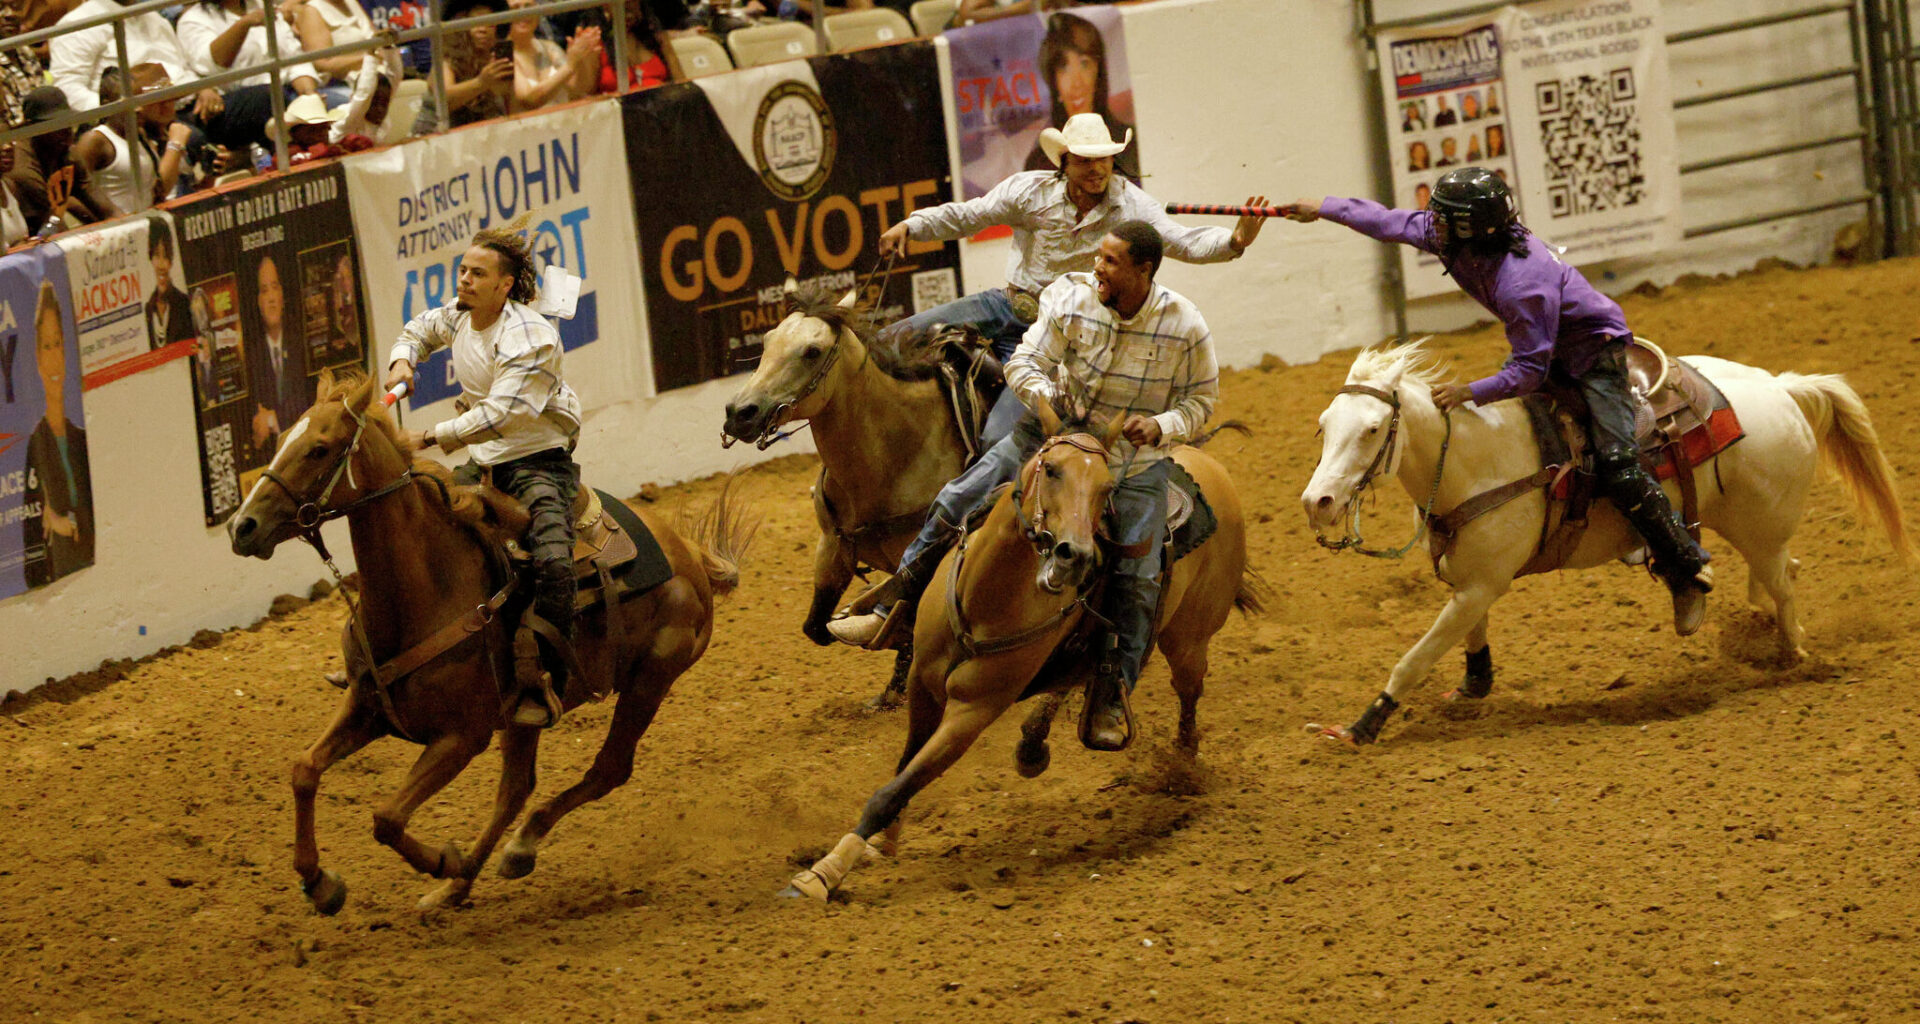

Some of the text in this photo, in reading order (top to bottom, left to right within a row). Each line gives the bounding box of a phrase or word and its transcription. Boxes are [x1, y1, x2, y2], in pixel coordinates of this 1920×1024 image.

[1520, 2, 1632, 31] CONGRATULATIONS
[1522, 34, 1544, 49] THE
[1577, 23, 1615, 40] TEXAS
[1616, 16, 1652, 34] BLACK
[1392, 29, 1499, 78] DEMOCRATIC
[957, 71, 1041, 114] STACI
[235, 193, 277, 226] GOLDEN
[277, 184, 303, 214] GATE
[304, 175, 338, 206] RADIO
[398, 172, 470, 228] DISTRICT
[479, 132, 580, 229] JOHN
[396, 211, 473, 260] ATTORNEY
[660, 178, 946, 302] GO VOTE
[75, 270, 142, 320] JACKSON
[819, 270, 856, 296] FROM
[28, 467, 38, 490] 6
